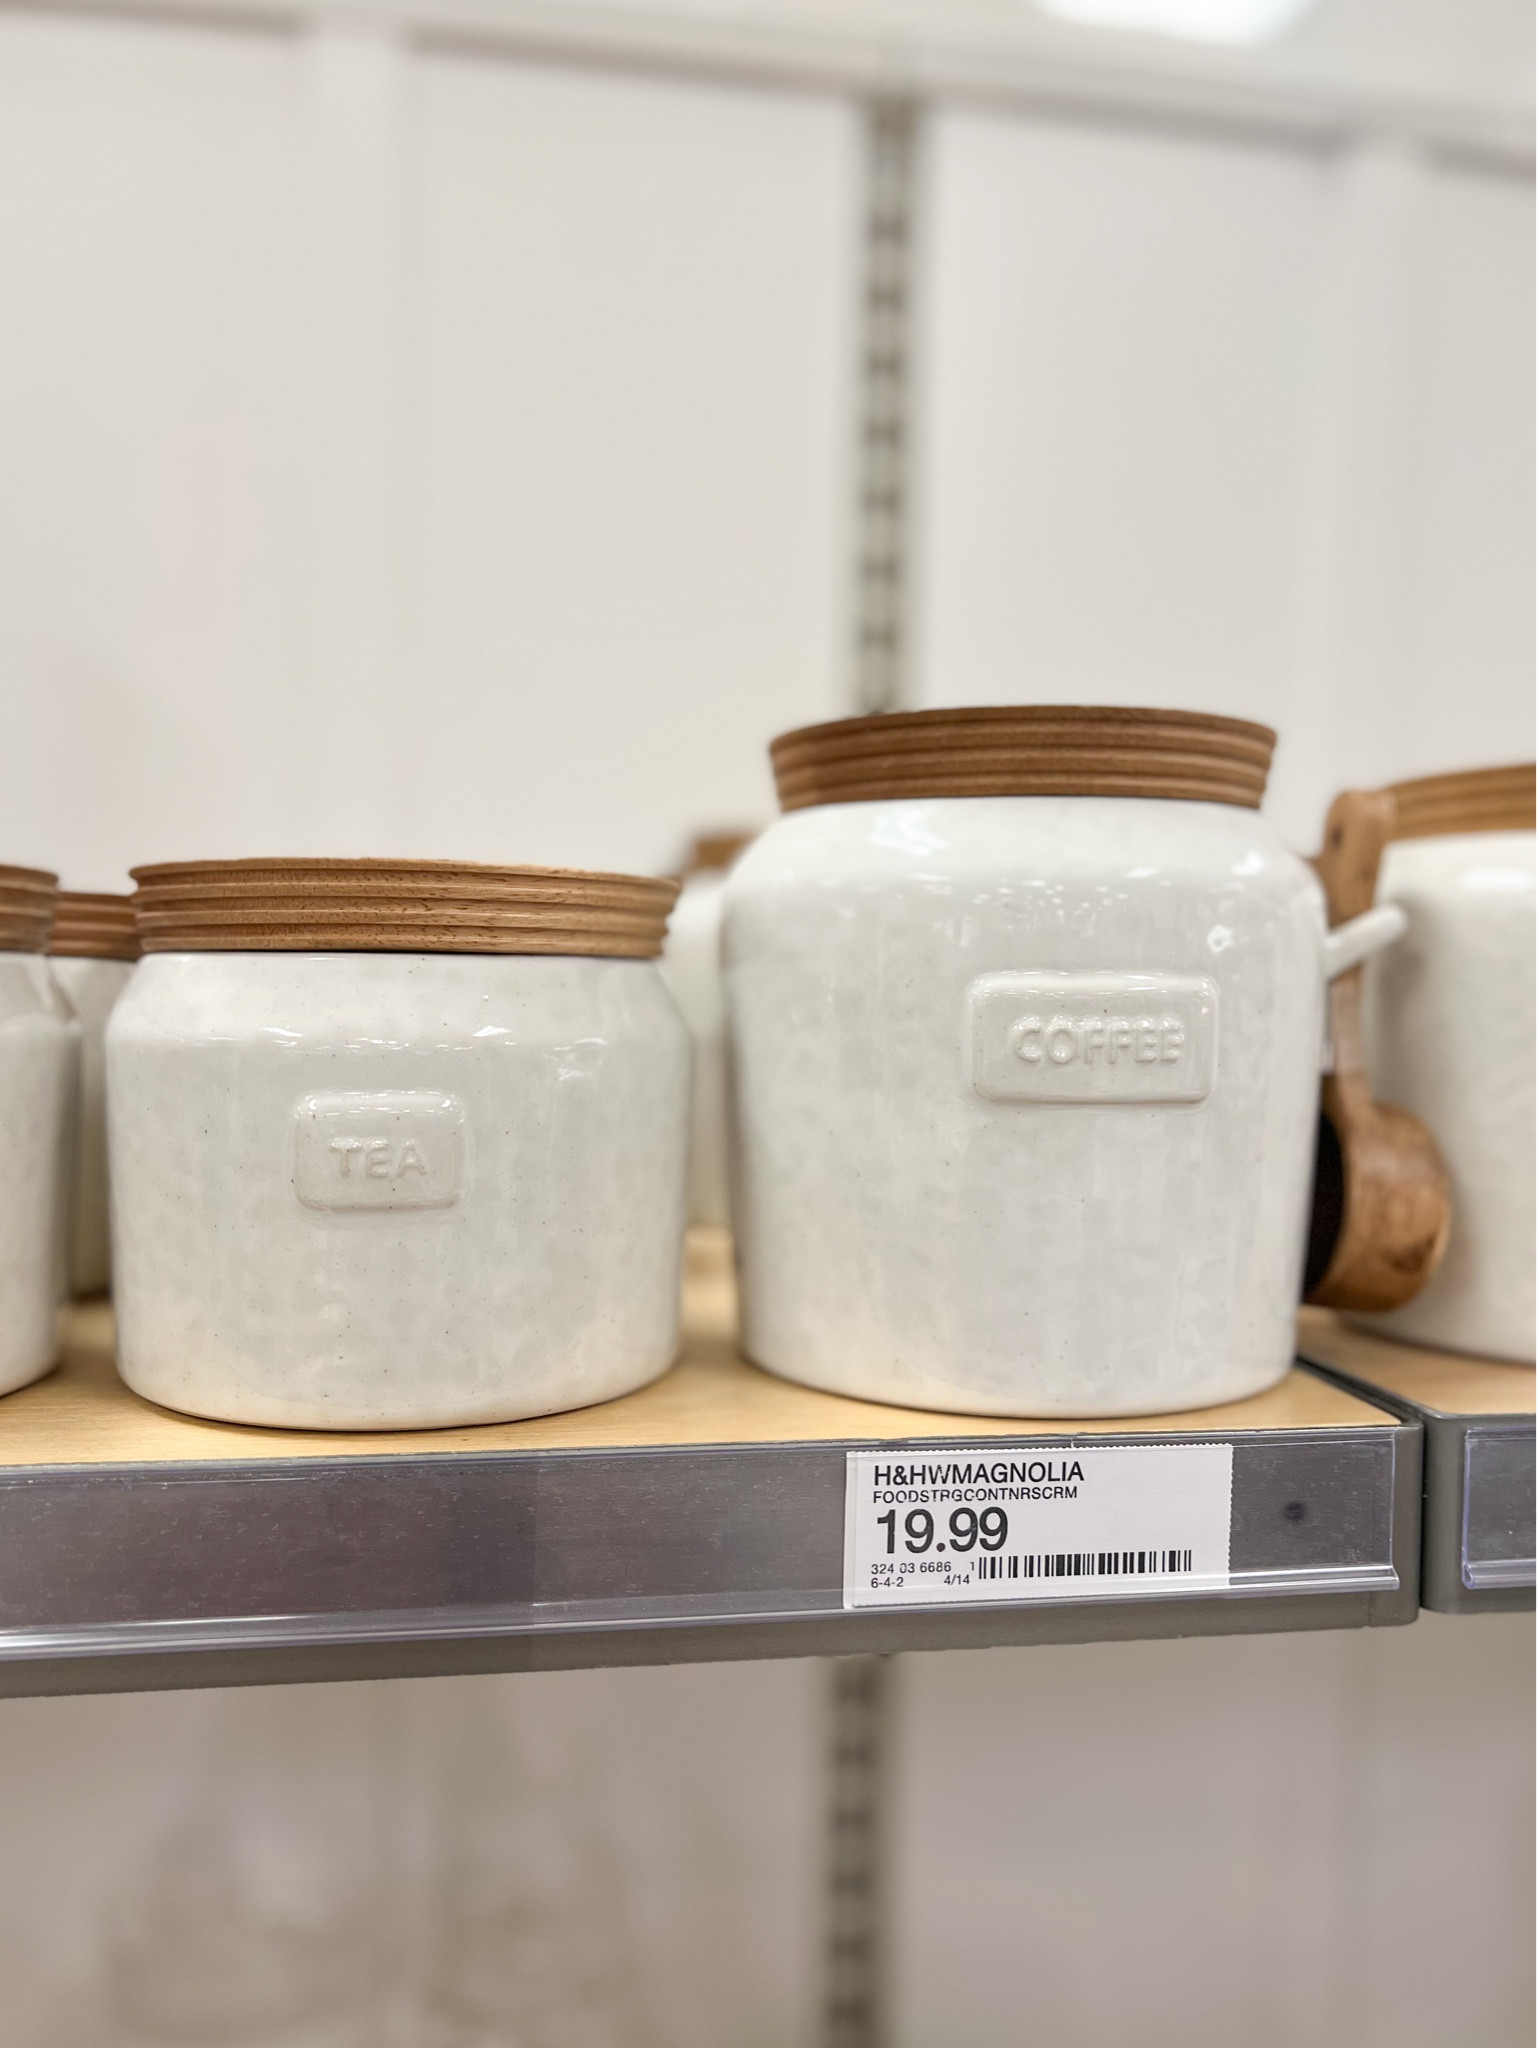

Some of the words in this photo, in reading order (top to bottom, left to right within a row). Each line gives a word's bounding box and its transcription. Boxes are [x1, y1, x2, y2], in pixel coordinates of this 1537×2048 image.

[1010, 1014, 1184, 1066] COFFEE
[328, 1137, 427, 1179] TEA
[873, 1461, 1085, 1487] H&HWMAGNOLIA
[873, 1486, 1078, 1504] FOODSTRGCONTNRSCRM
[876, 1506, 1009, 1554] 19.99
[871, 1563, 894, 1575] 324
[899, 1562, 915, 1574] 03
[919, 1561, 952, 1573] 6686
[870, 1576, 904, 1589] 6-4-2
[943, 1574, 970, 1585] 4/14
